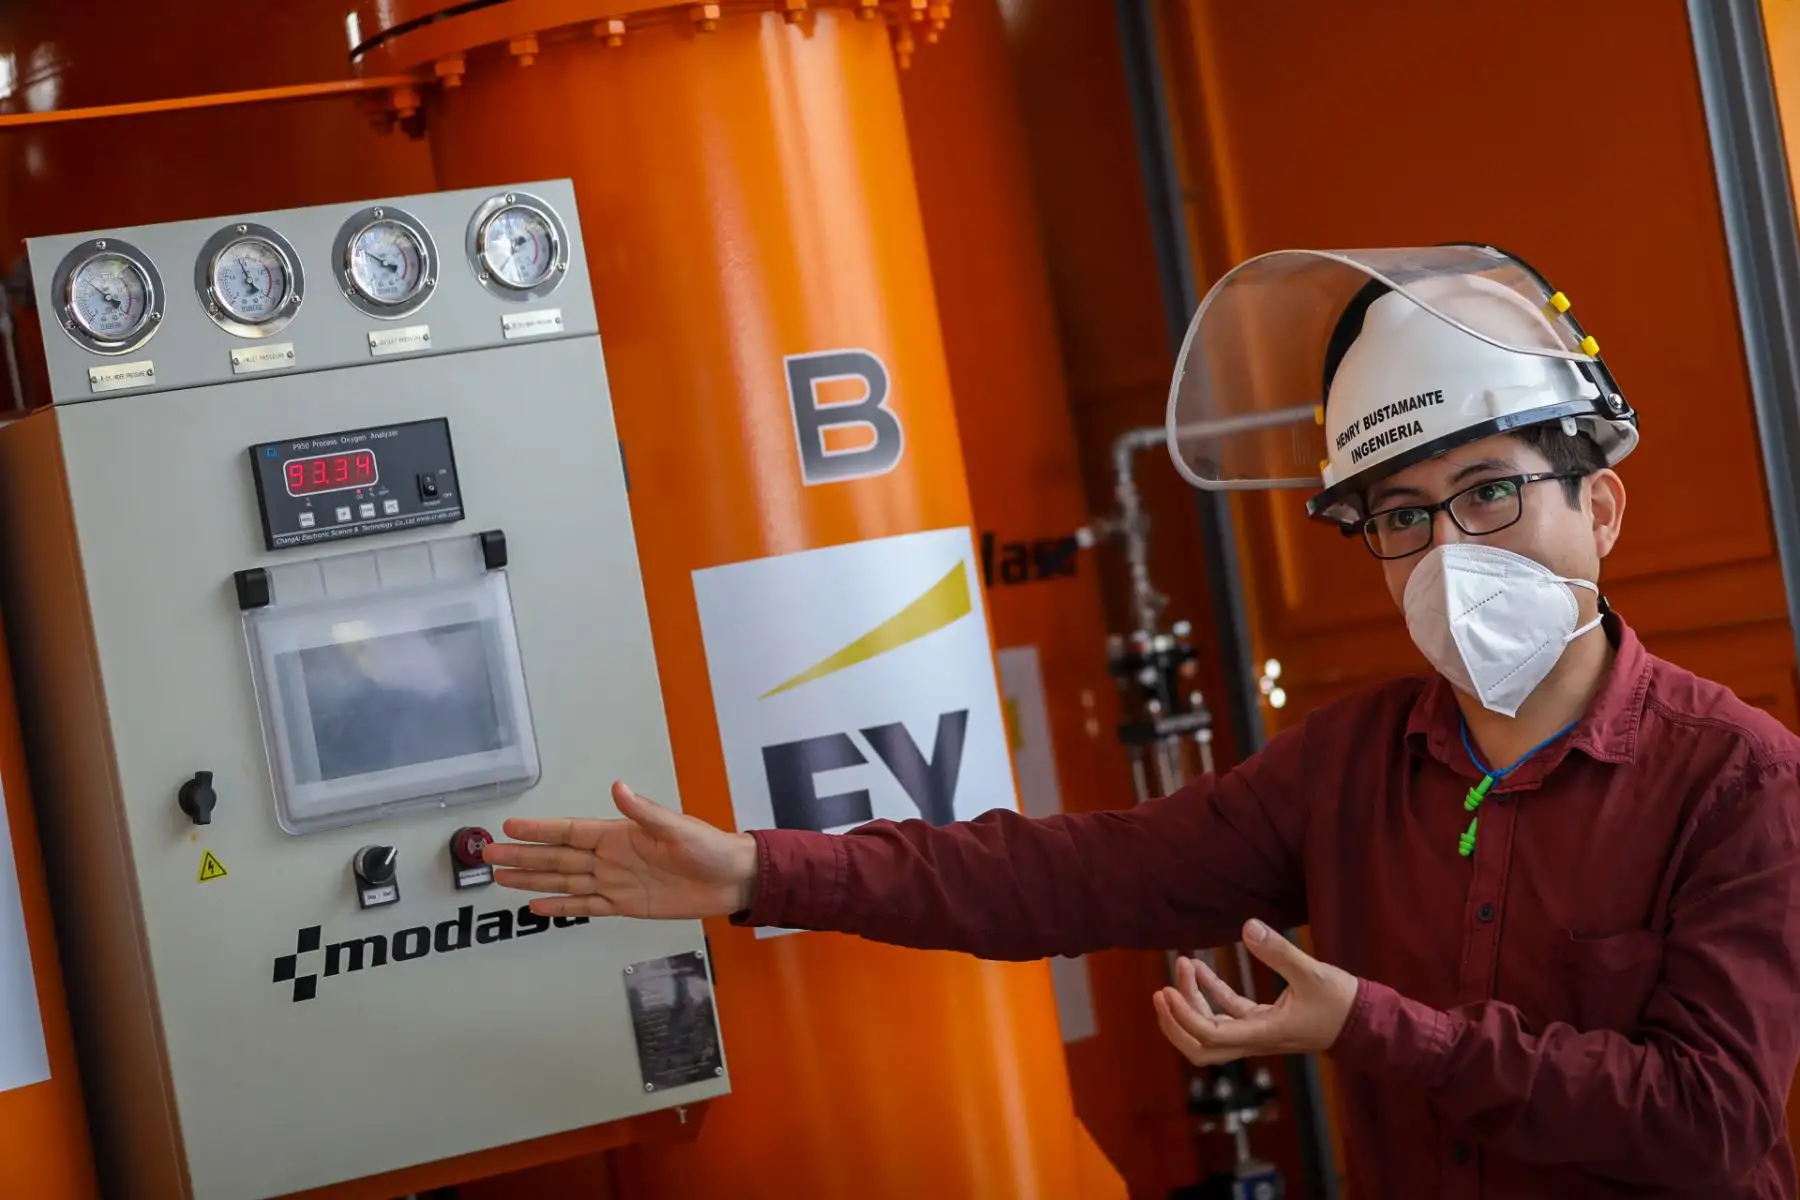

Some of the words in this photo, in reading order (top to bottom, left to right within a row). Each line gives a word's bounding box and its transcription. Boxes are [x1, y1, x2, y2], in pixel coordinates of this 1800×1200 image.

[312, 439, 337, 448] Process
[340, 434, 367, 444] Oxygen
[370, 430, 399, 440] Analyzer
[783, 348, 905, 487] B
[1335, 420, 1360, 451] HENRY
[1362, 389, 1444, 431] BUSTAMANTE
[1350, 420, 1423, 464] INGENIERIA
[301, 530, 330, 541] Electronic
[330, 527, 352, 537] Science
[362, 521, 394, 531] Technology
[761, 709, 969, 831] EY
